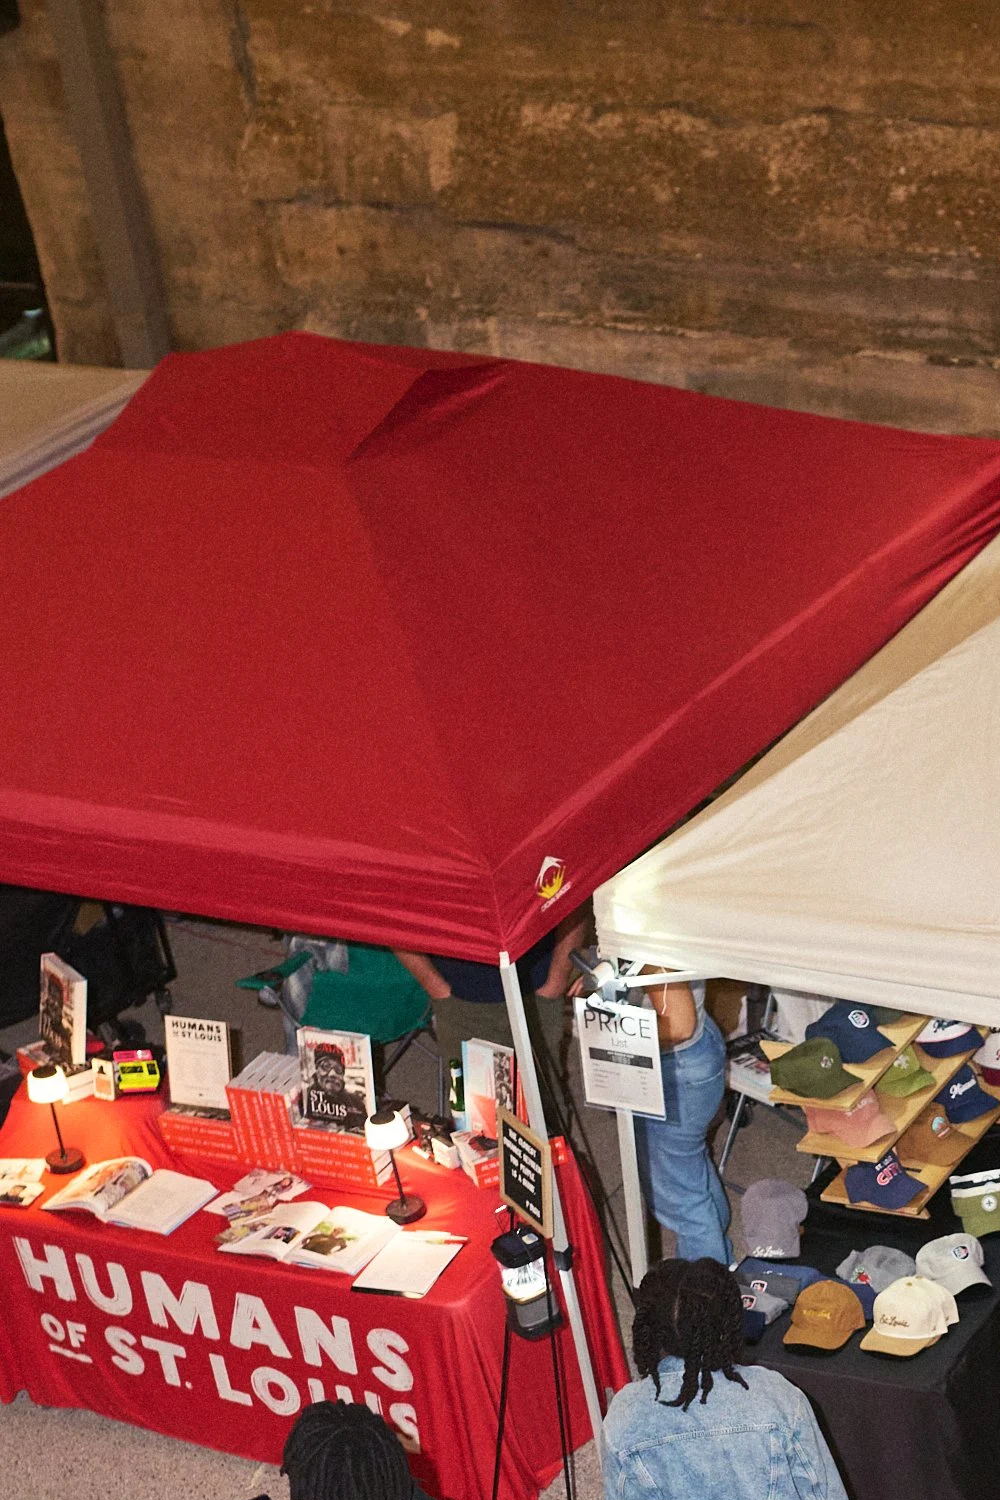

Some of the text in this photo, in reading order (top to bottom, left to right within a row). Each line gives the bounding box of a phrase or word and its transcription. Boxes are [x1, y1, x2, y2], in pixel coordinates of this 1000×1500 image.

[172, 1020, 221, 1033] HUMANS
[584, 1009, 651, 1039] PRICE
[195, 1031, 221, 1042] LOUIS
[311, 1100, 347, 1117] LOUIS
[877, 1162, 902, 1186] CIT
[12, 1236, 414, 1392] HUMANS
[40, 1312, 87, 1348] OF
[104, 1326, 193, 1390] ST.
